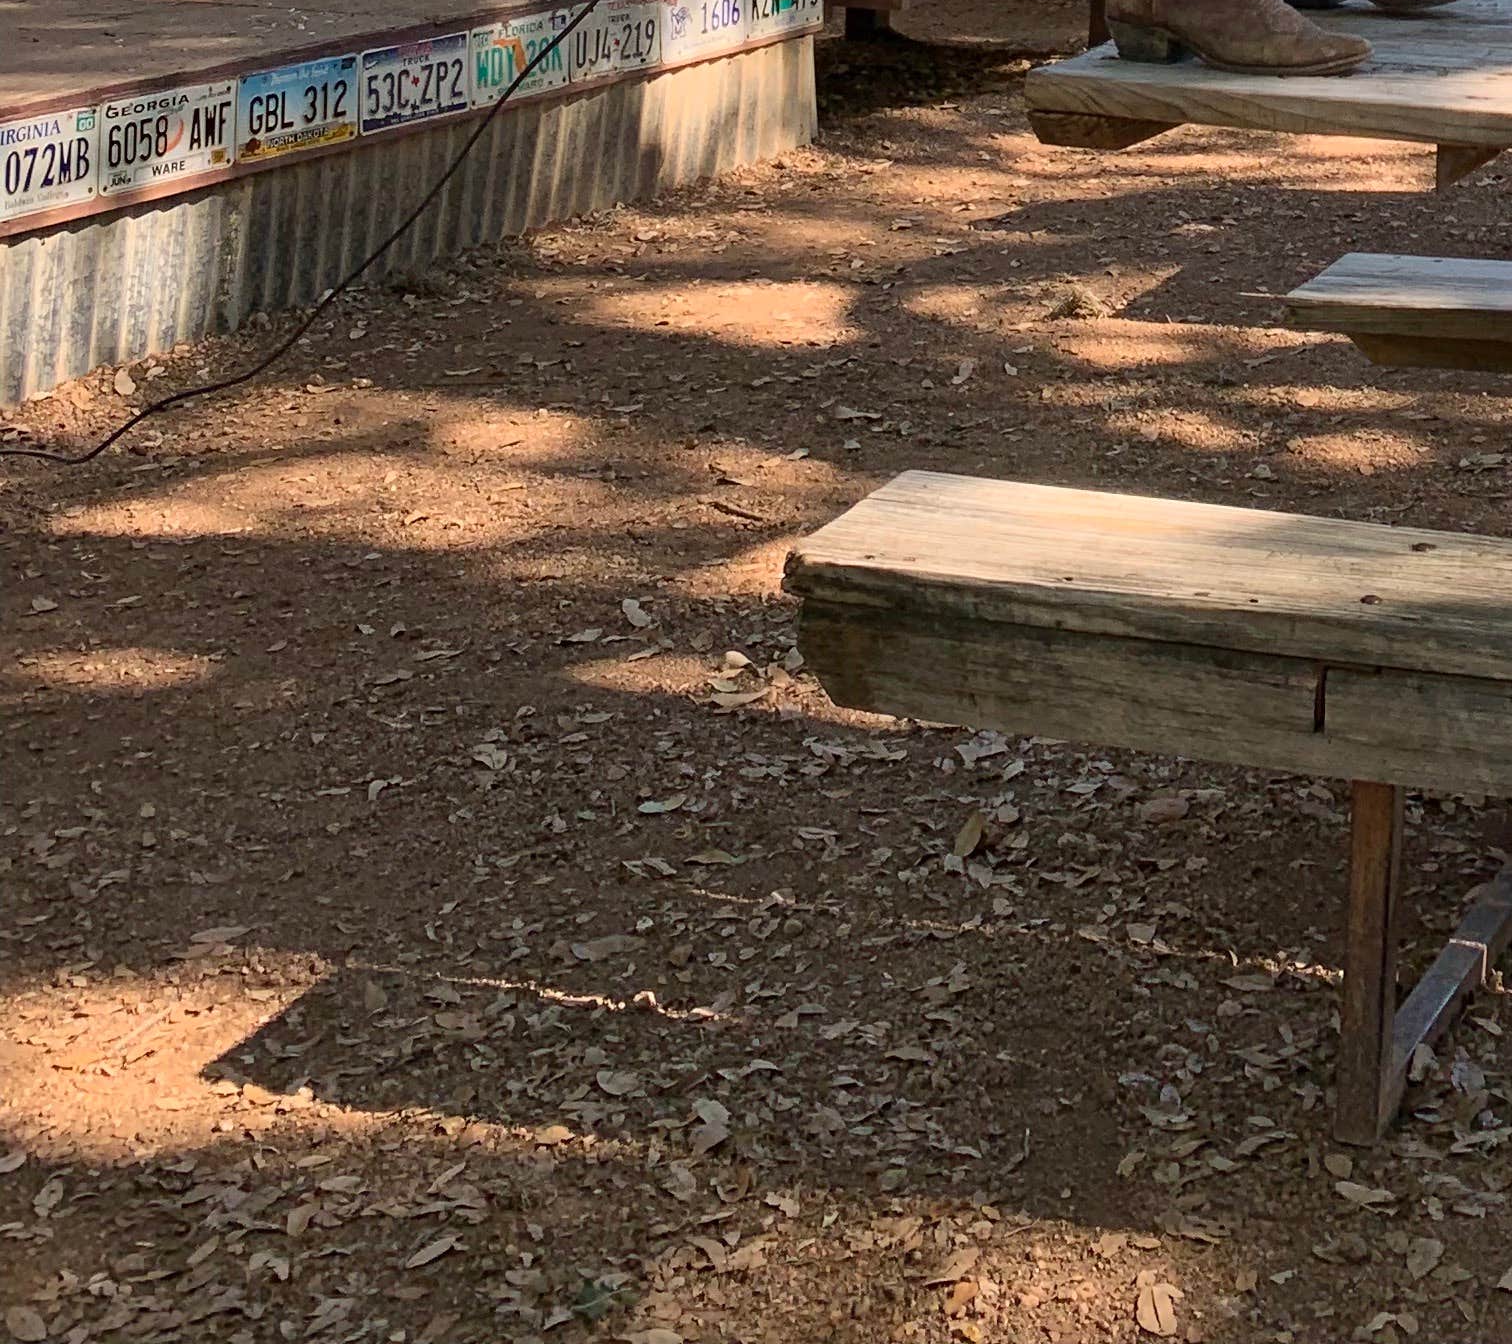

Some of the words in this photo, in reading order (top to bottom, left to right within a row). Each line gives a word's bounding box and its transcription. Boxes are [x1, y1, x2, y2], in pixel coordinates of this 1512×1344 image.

[621, 18, 655, 60] 219
[105, 94, 190, 120] GEORGIA
[249, 90, 295, 135] GBL
[303, 79, 348, 124] 312
[108, 114, 169, 169] 6058
[189, 100, 232, 152] AWF
[5, 136, 90, 196] 072MB
[152, 160, 186, 177] WARE
